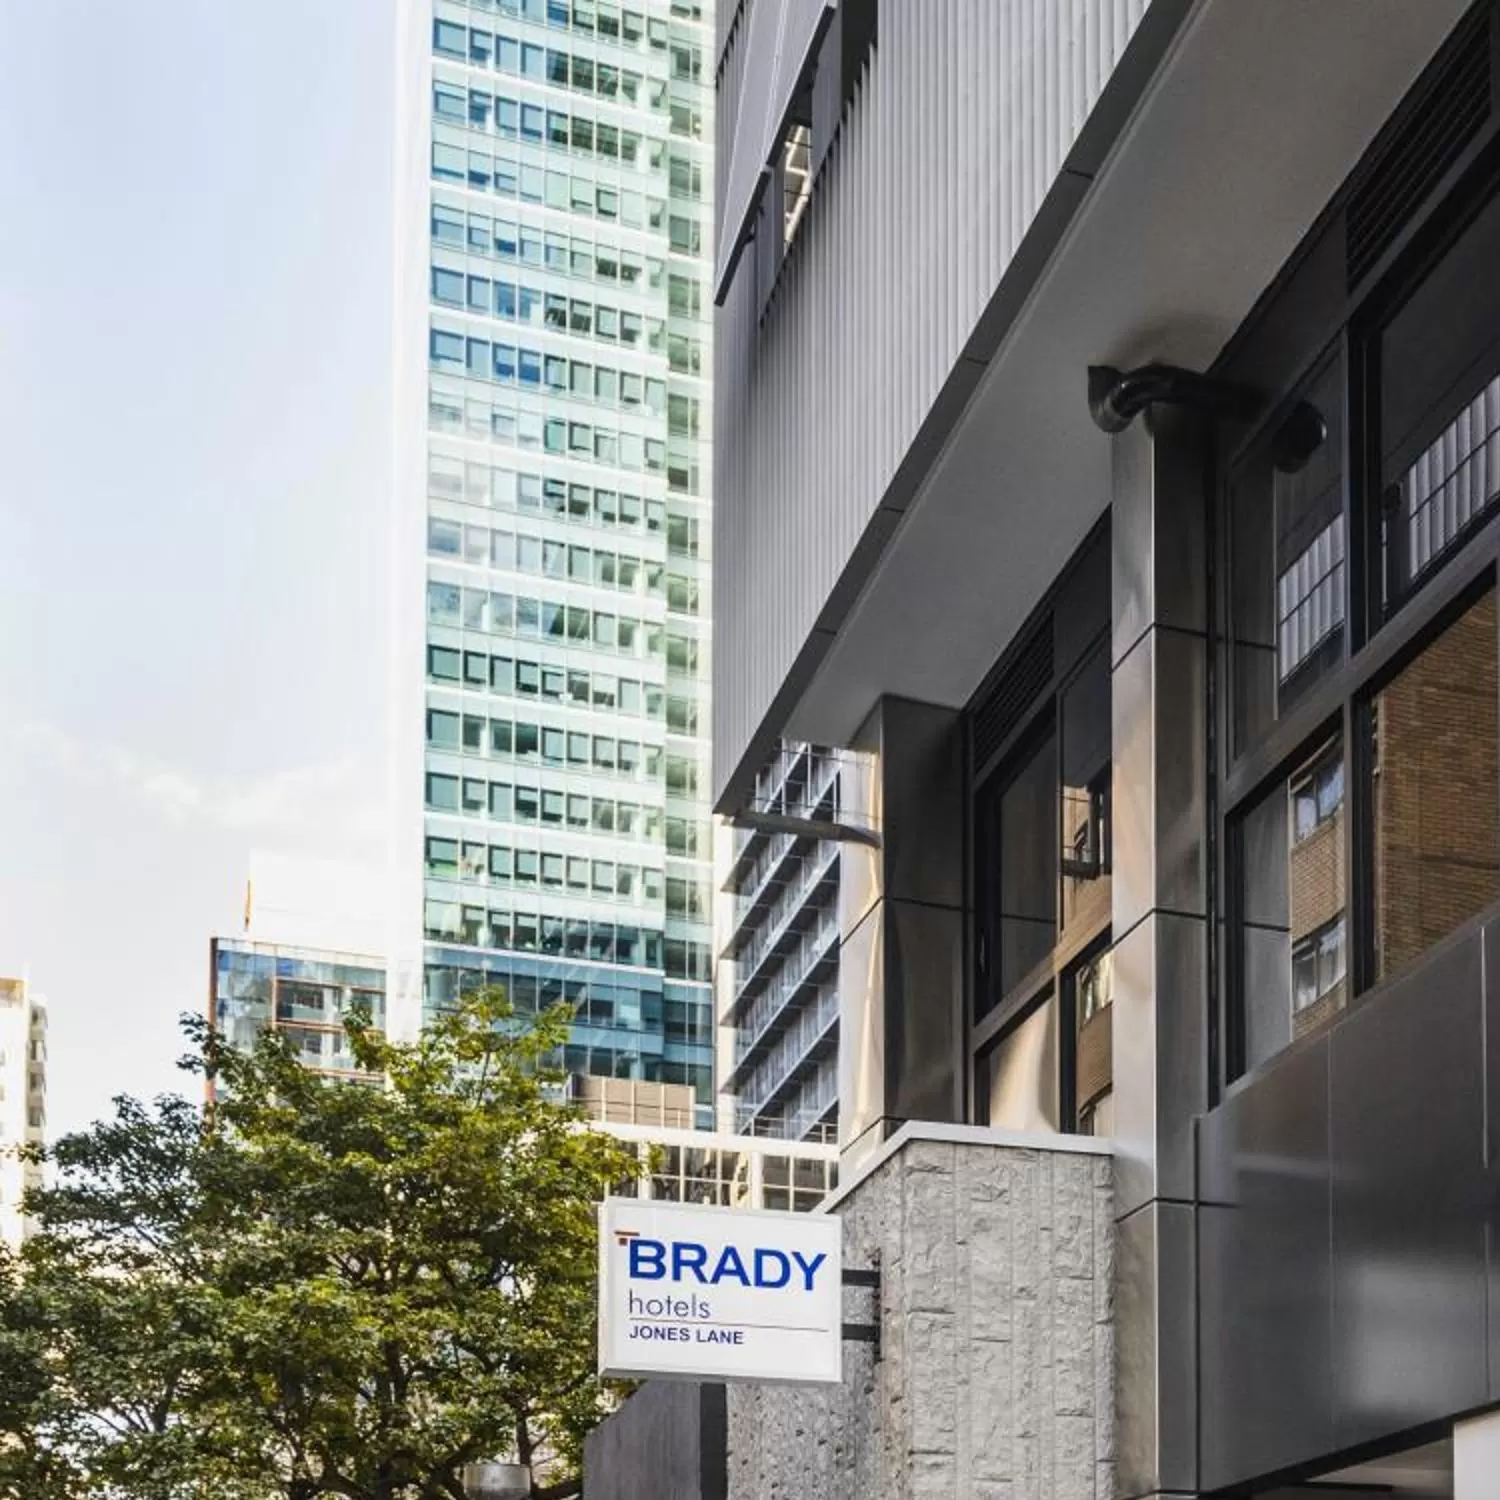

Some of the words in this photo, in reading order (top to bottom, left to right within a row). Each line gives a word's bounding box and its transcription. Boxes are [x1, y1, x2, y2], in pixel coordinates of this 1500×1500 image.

[629, 1239, 827, 1291] BRADY
[629, 1288, 711, 1319] hotels
[629, 1325, 691, 1342] JONES
[695, 1328, 745, 1345] LANE
